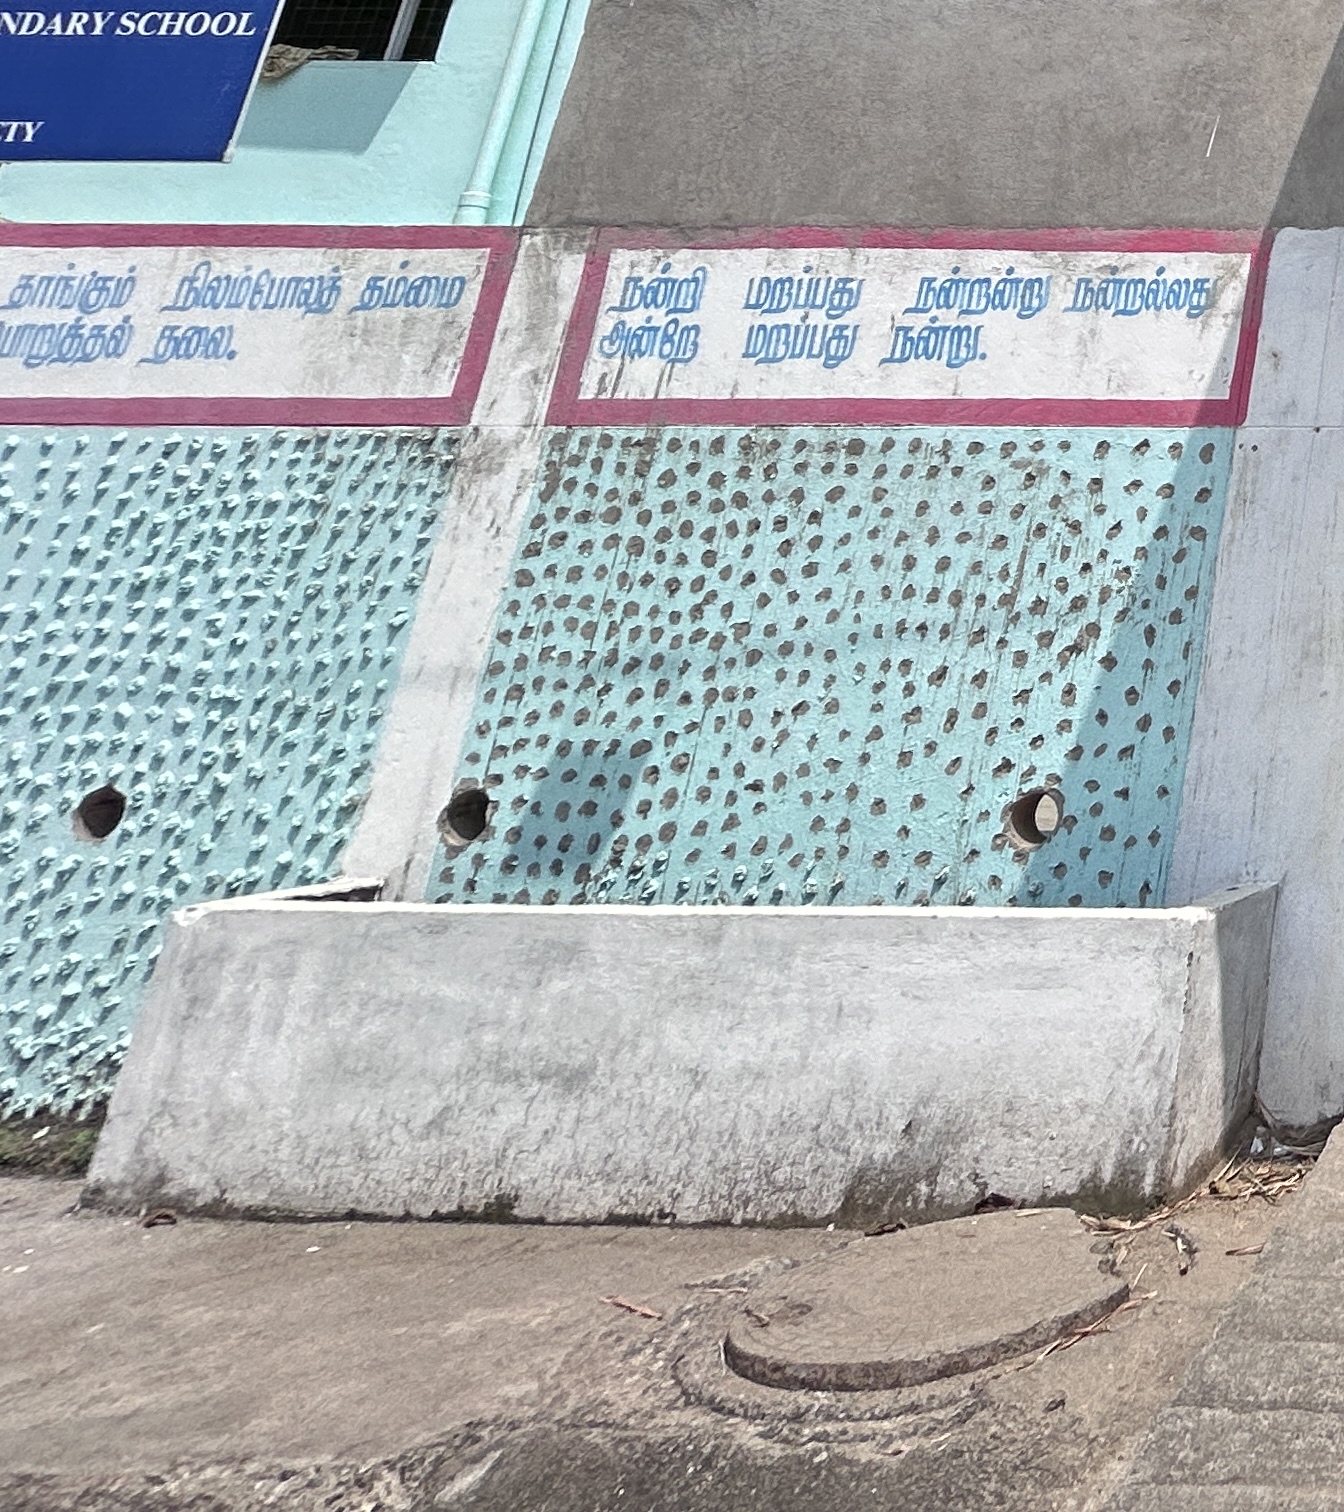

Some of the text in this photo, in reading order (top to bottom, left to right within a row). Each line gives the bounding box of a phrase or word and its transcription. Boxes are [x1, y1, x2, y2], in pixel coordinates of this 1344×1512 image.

[115, 11, 257, 36] SCHOOL
[605, 262, 707, 317] நன்றி
[902, 266, 1053, 320] நன்றன்று
[878, 316, 987, 369] நன்று.
